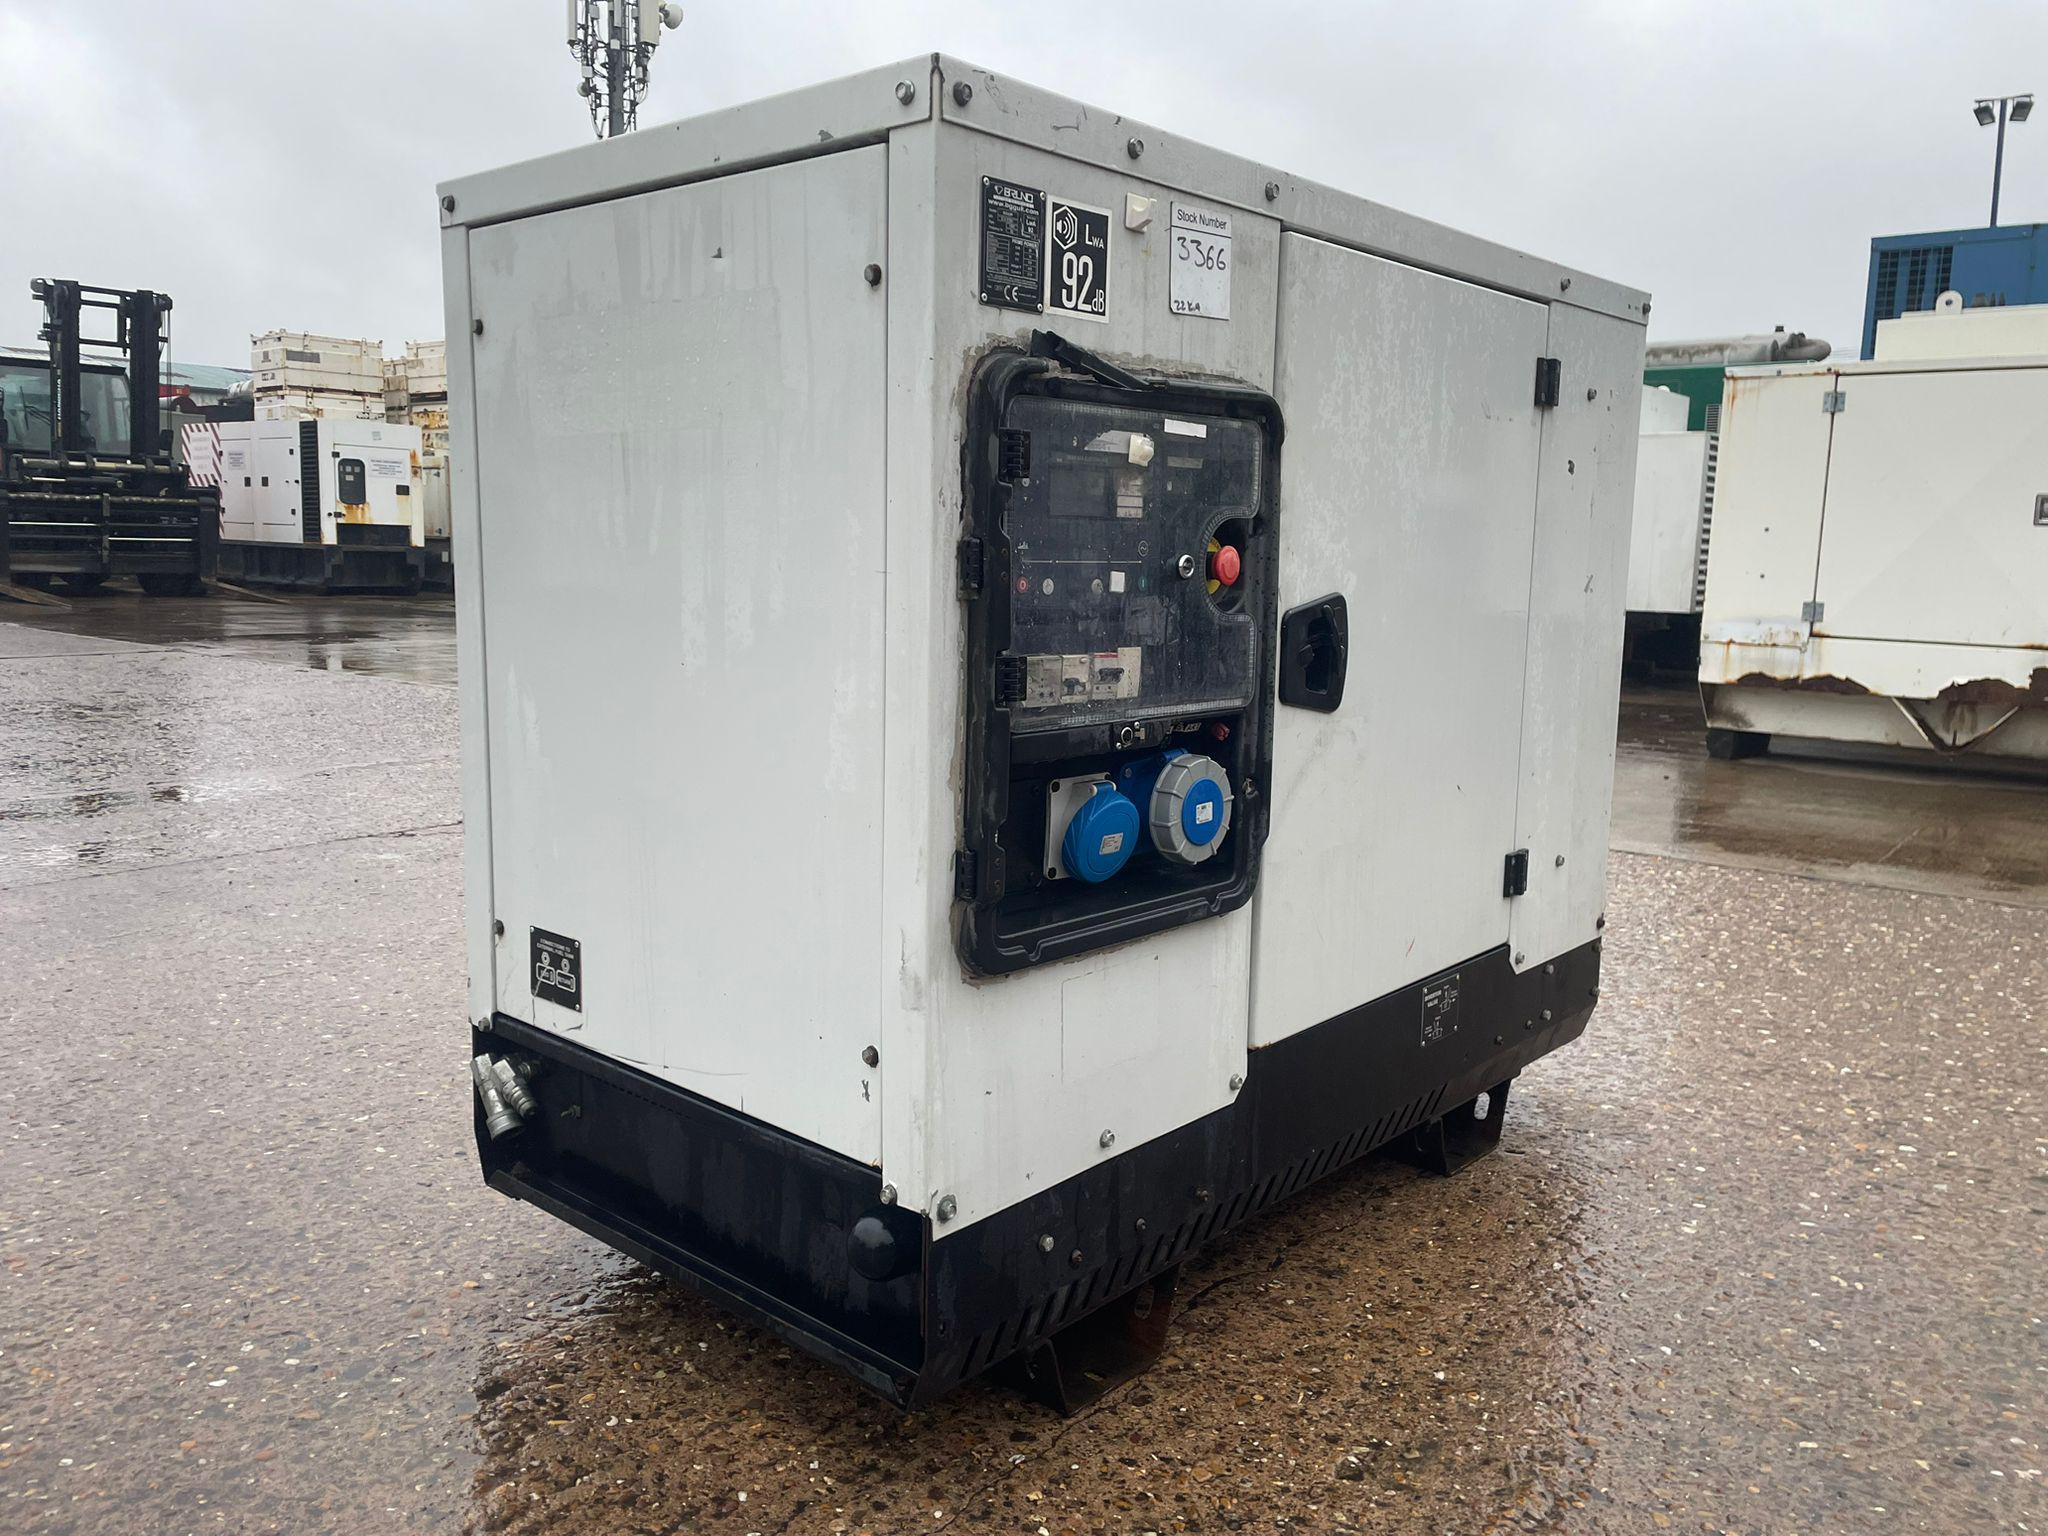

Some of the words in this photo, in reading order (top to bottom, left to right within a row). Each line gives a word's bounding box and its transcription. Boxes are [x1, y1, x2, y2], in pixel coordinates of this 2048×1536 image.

[1004, 187, 1033, 203] BRUNO
[1177, 209, 1197, 224] Stock
[1199, 214, 1227, 230] Number
[1177, 237, 1226, 270] 3366
[1062, 252, 1093, 311] 92
[1092, 289, 1104, 312] dB
[1004, 285, 1019, 303] CE
